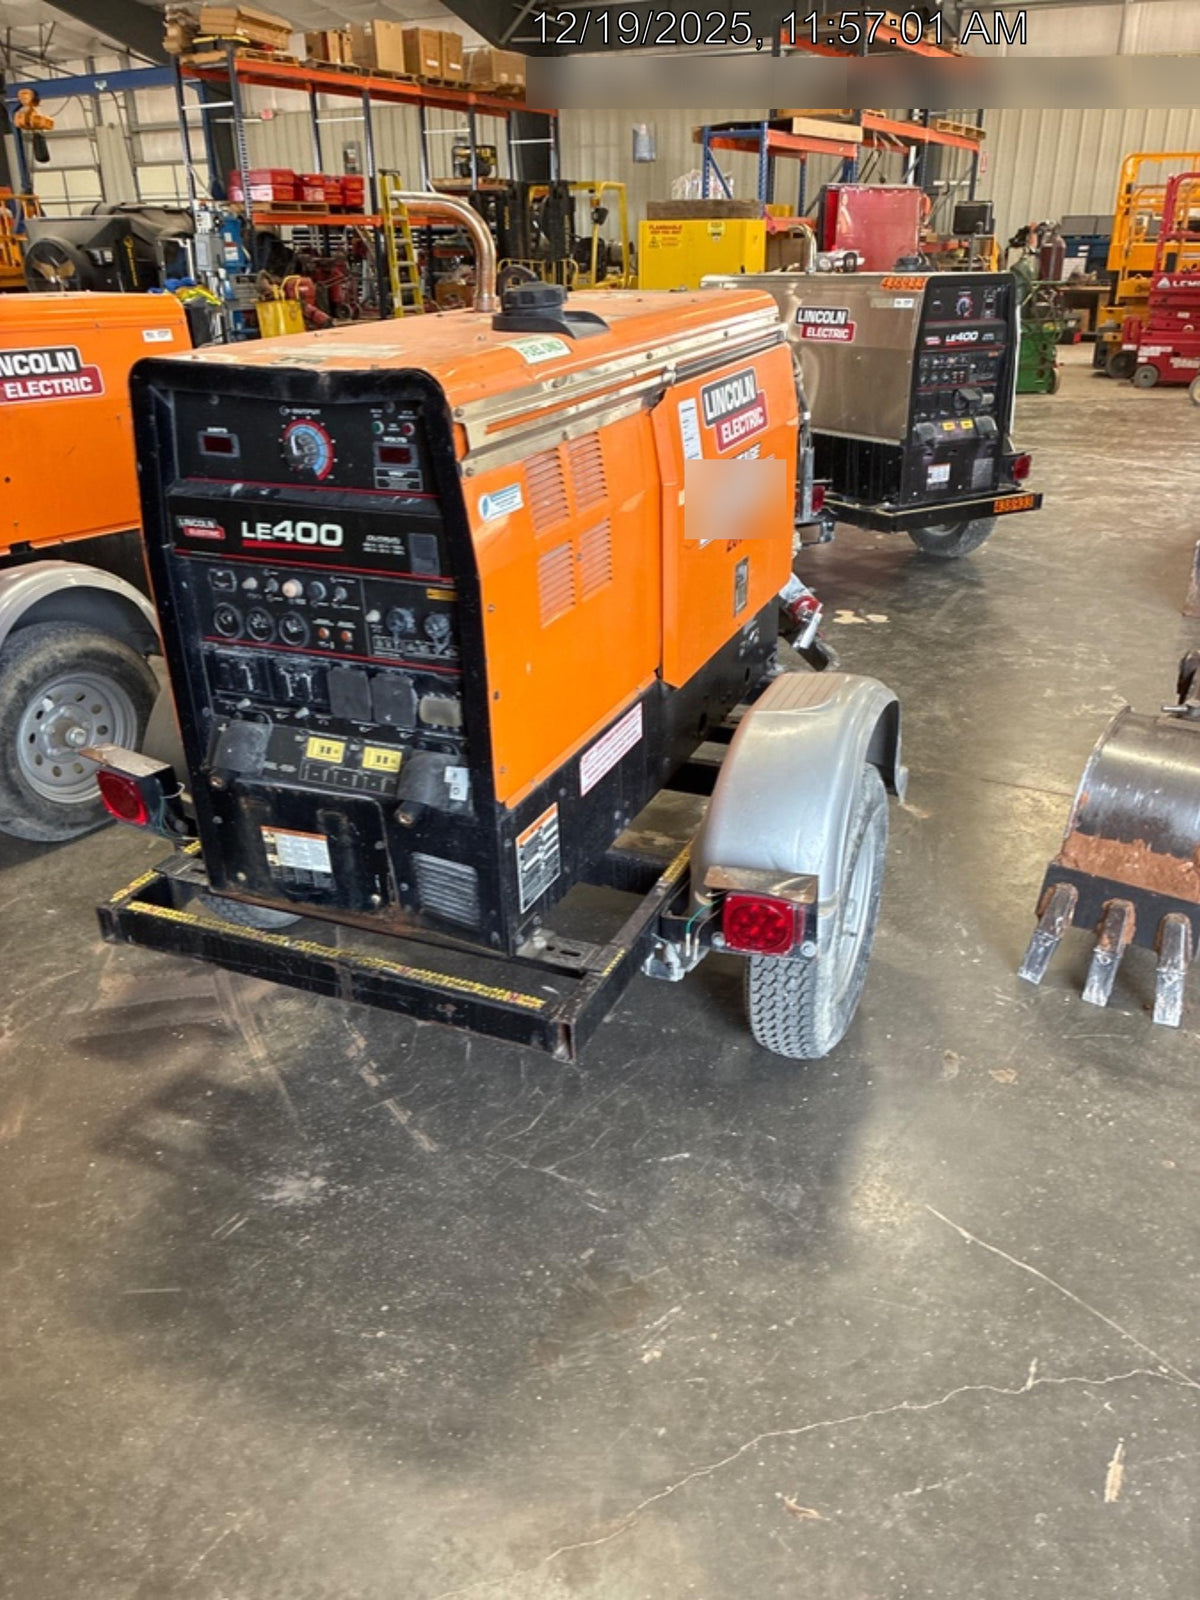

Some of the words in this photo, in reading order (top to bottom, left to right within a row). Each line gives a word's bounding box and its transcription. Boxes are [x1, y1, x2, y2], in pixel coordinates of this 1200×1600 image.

[797, 310, 846, 325] LINCOLN
[805, 327, 850, 339] ELECTRIC
[5, 376, 93, 399] ELECTRIC
[703, 374, 756, 421] LINCOLN
[721, 406, 765, 445] ELECTRIC
[178, 518, 216, 528] LINCOLN
[241, 520, 343, 547] LE400
